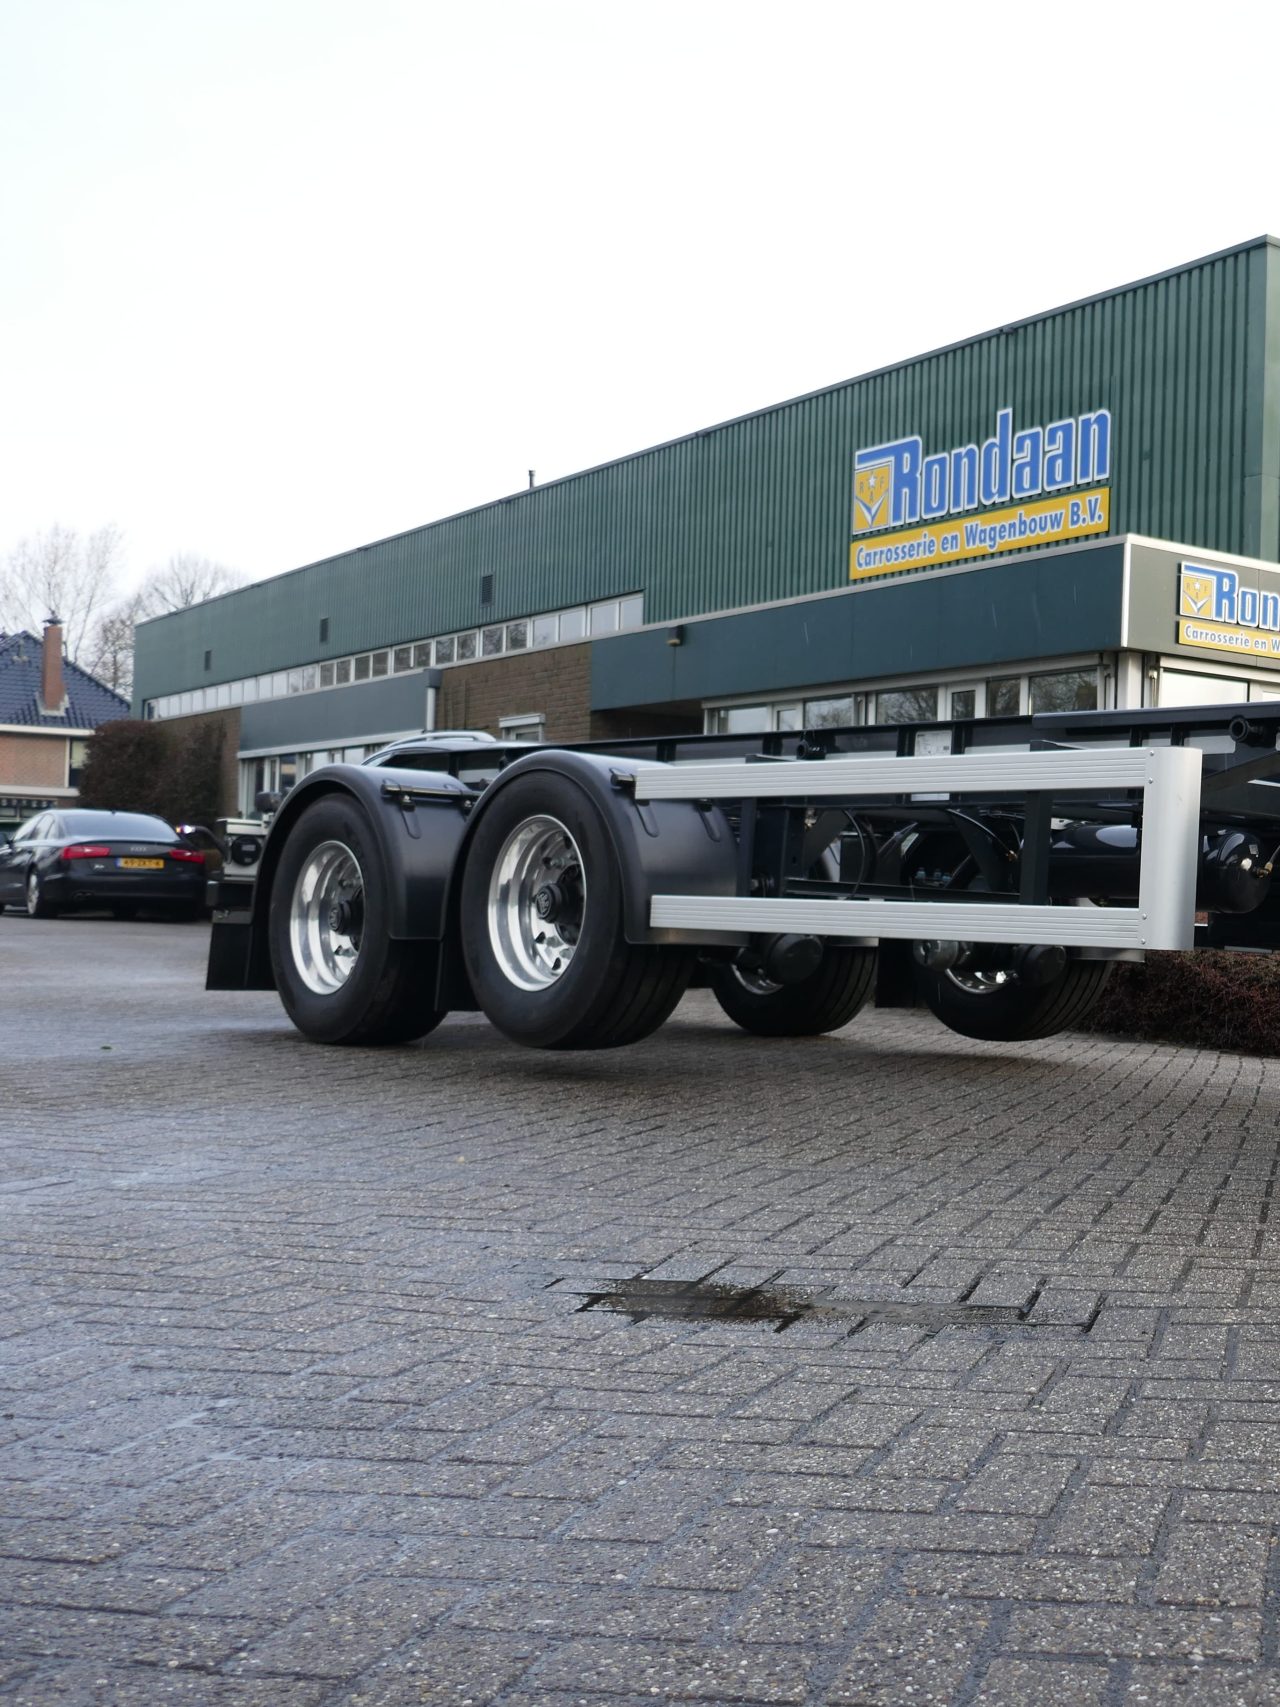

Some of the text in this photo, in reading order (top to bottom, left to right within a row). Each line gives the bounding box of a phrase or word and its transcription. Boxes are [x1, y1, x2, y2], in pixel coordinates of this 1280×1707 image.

[855, 408, 1111, 526] Rondaan
[857, 497, 1103, 569] Carrosserie en Wagenbouw B.V.
[1185, 625, 1250, 647] Carrosserie
[1254, 639, 1267, 650] en
